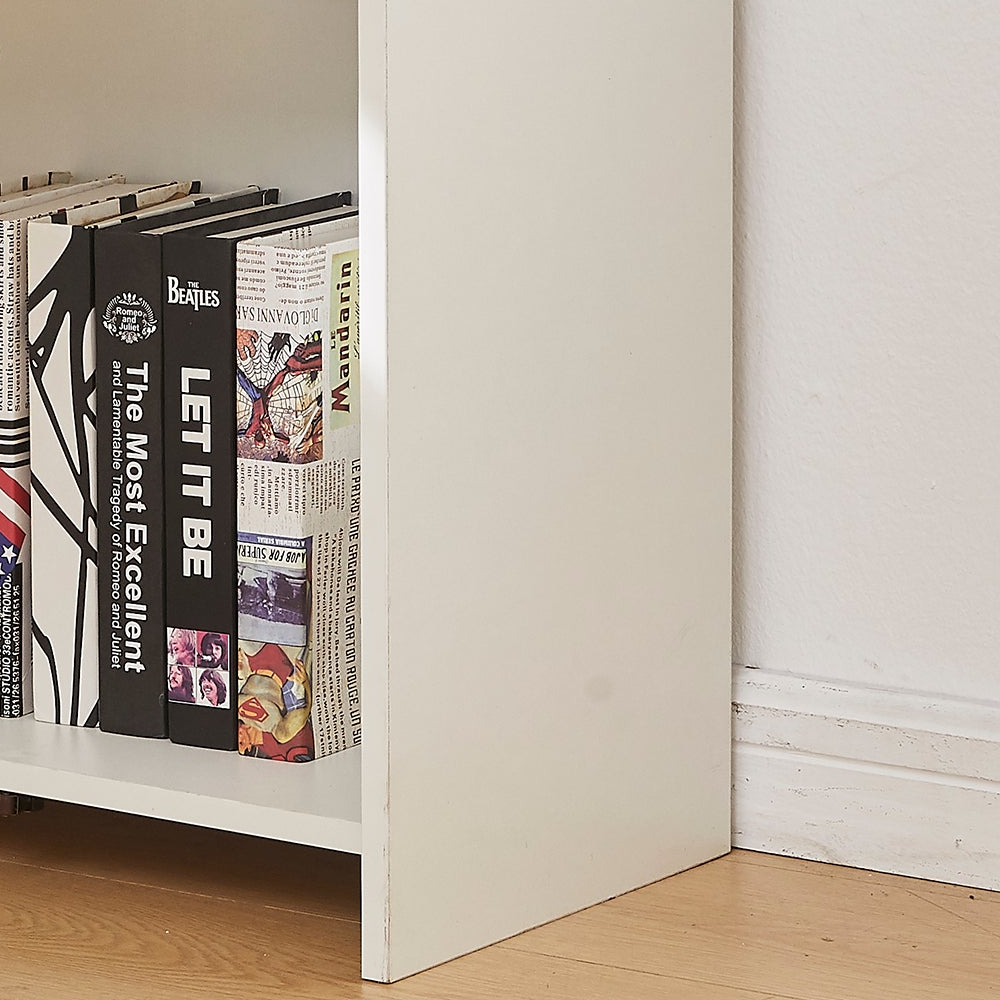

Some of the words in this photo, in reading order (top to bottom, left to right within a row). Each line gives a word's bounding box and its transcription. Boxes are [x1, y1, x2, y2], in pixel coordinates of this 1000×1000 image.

[6, 282, 14, 314] Straw
[167, 276, 220, 311] BEATLES
[188, 281, 199, 289] THE
[116, 307, 143, 317] Romeo
[119, 322, 140, 332] Juliet
[122, 315, 137, 323] and
[331, 261, 352, 413] Mandarin
[6, 363, 14, 411] romantic
[112, 360, 123, 387] and
[126, 362, 149, 422] The
[181, 367, 211, 453] LET
[112, 390, 124, 470] Lamentable
[124, 432, 149, 514] Most
[351, 458, 361, 473] LE
[110, 474, 123, 530] Tragedy
[182, 463, 212, 507] IT
[112, 534, 122, 548] of
[182, 517, 212, 578] BE
[269, 549, 285, 561] FOR
[286, 552, 300, 563] JOB
[111, 550, 122, 600] Romeo
[124, 522, 148, 674] Excellent
[346, 596, 356, 613] AU
[111, 603, 122, 630] and
[110, 632, 122, 669] Juliet
[345, 615, 356, 664] CARTON
[2, 657, 10, 693] STUDIO
